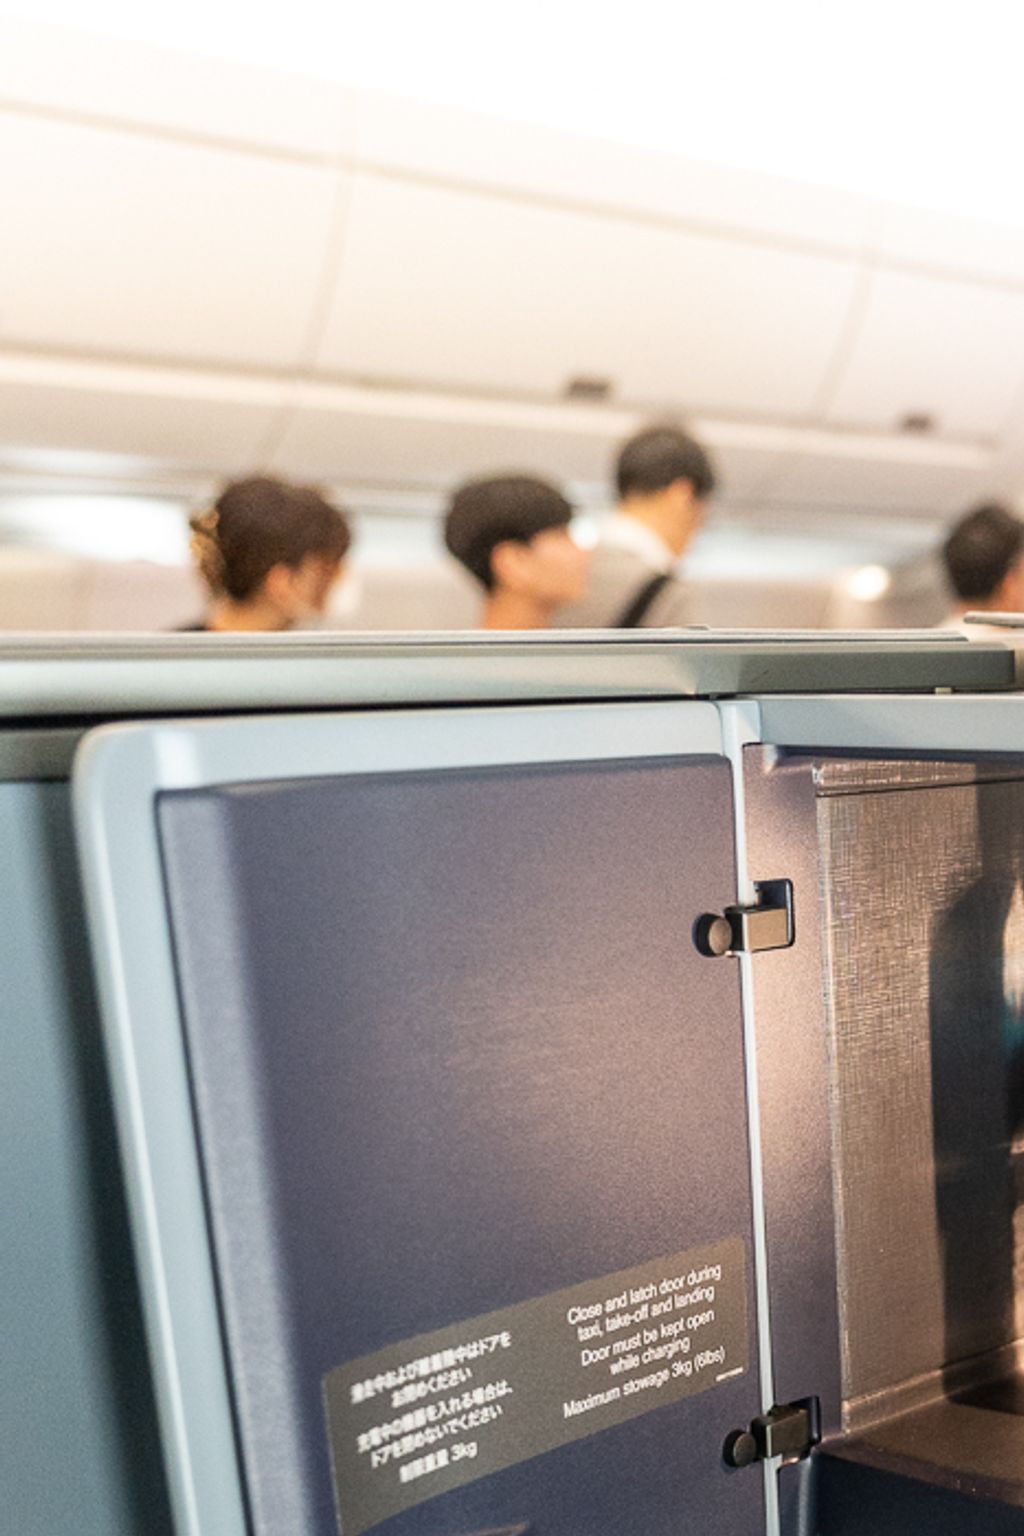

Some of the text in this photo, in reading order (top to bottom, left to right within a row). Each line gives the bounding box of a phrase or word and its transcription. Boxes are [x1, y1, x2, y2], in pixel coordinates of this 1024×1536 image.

[567, 1264, 722, 1324] Close and latch door during
[577, 1286, 715, 1342] taxi, take-off and landing
[580, 1309, 715, 1367] Door must be kept open
[609, 1335, 691, 1376] while charging
[391, 1366, 473, 1409] おめください
[563, 1387, 621, 1418] Maximum
[622, 1369, 671, 1395] stowage
[671, 1359, 693, 1379] 3kg
[693, 1345, 727, 1372] (6lbs)
[371, 1404, 504, 1469] ドアをめないでください
[451, 1441, 478, 1462] 3kg
